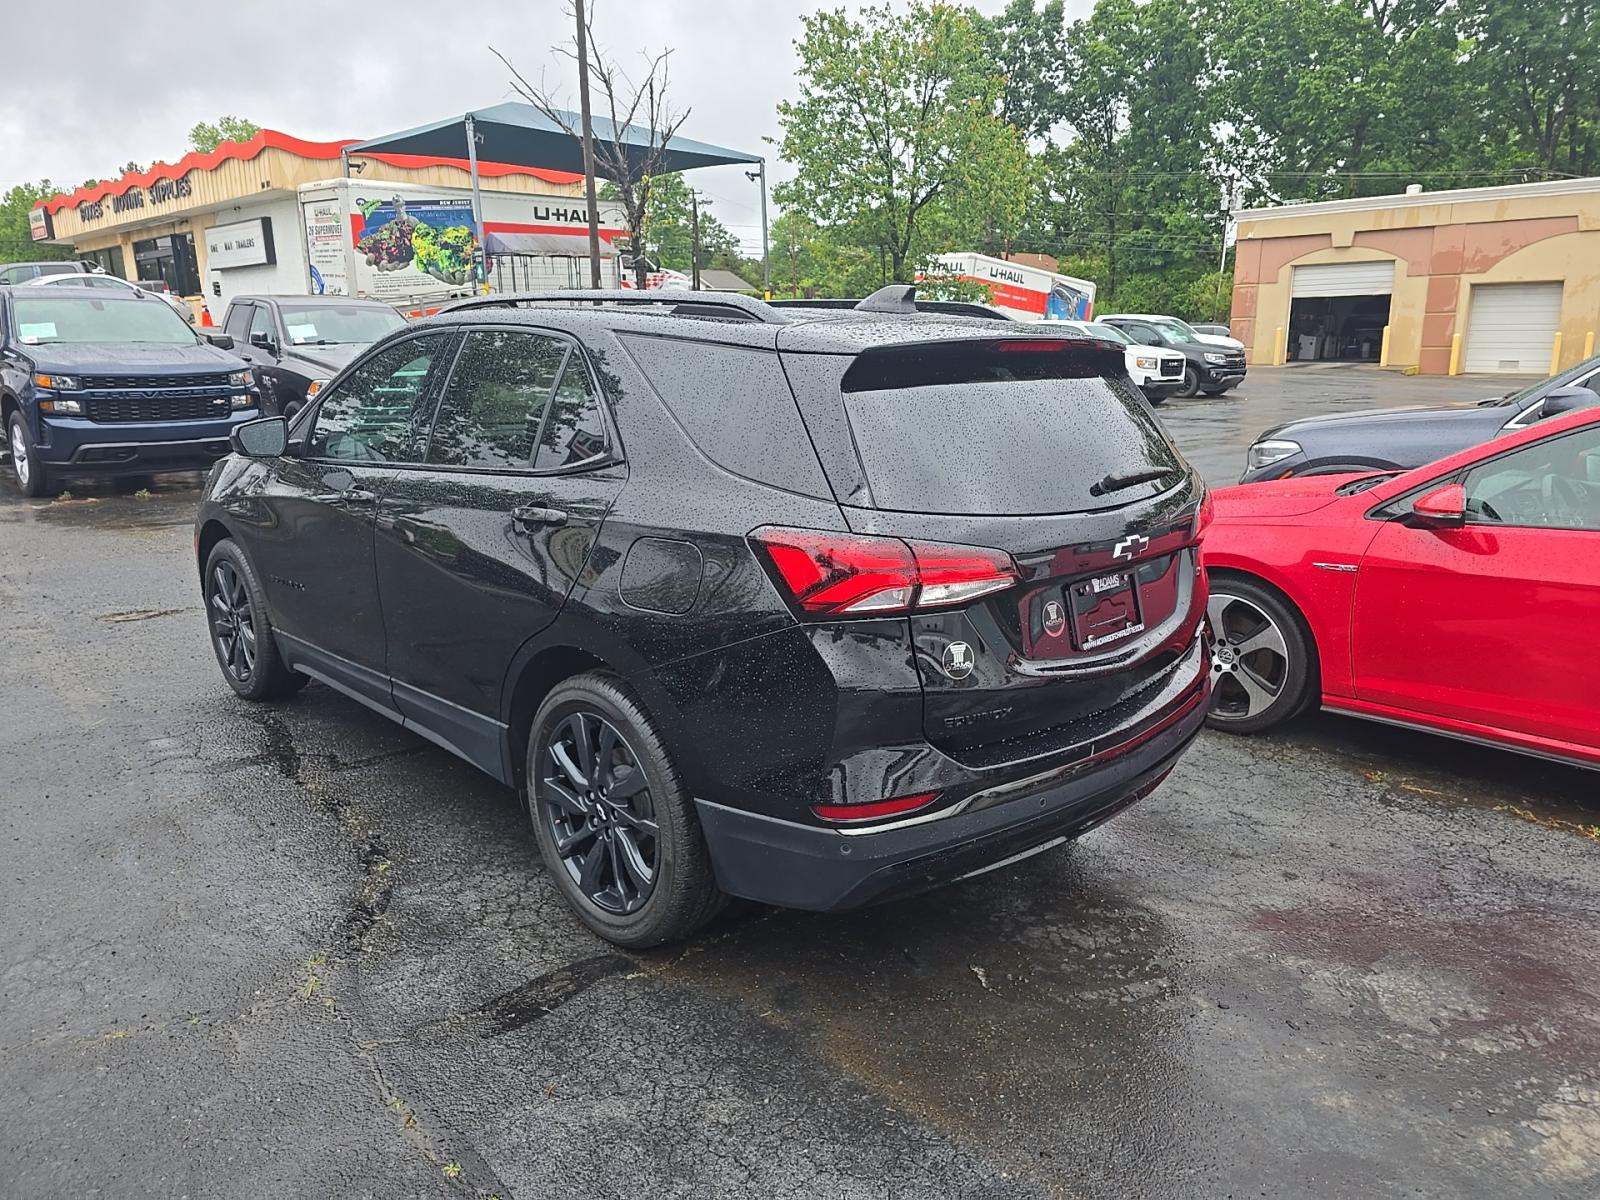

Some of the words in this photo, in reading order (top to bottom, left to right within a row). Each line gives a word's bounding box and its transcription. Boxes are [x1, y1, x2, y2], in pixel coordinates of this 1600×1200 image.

[112, 190, 144, 214] MOVING
[149, 176, 192, 206] SUPPLIES
[533, 206, 605, 225] U-HAUL
[224, 241, 233, 251] WAY
[235, 237, 255, 250] TRAILERS
[989, 266, 1025, 285] U-HAUL
[1099, 574, 1120, 589] ADAMS
